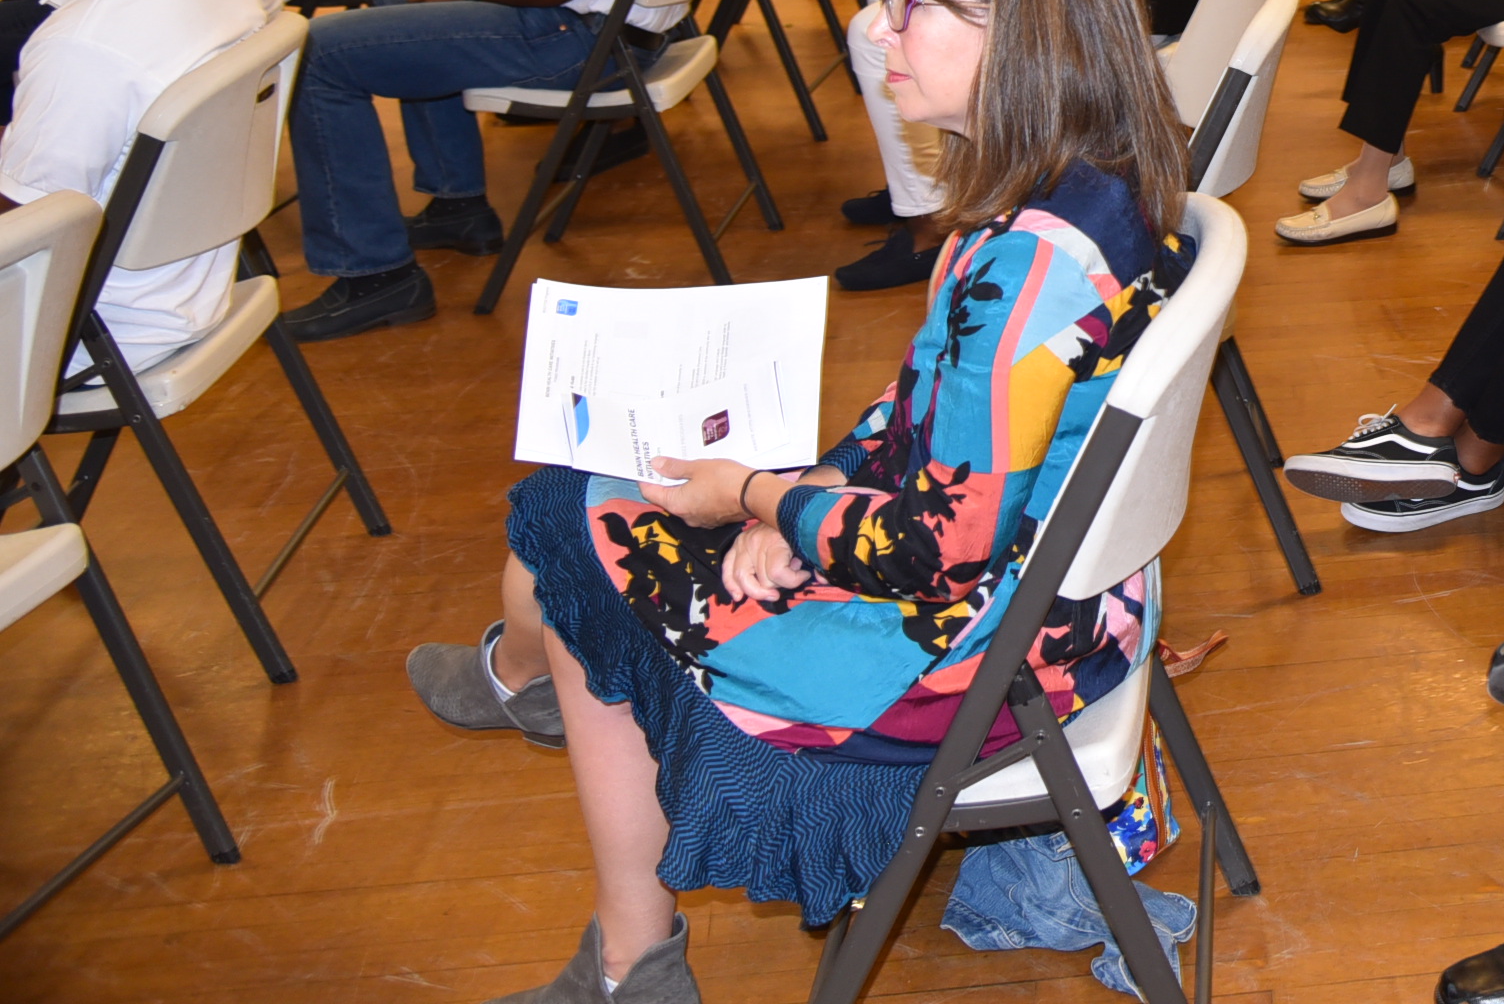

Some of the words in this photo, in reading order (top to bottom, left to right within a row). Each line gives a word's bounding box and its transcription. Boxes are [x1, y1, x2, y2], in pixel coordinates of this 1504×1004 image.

[626, 408, 637, 427] CARE
[629, 428, 641, 454] HEALTH
[633, 455, 644, 477] BENIN
[641, 441, 654, 479] INITIATIVES
